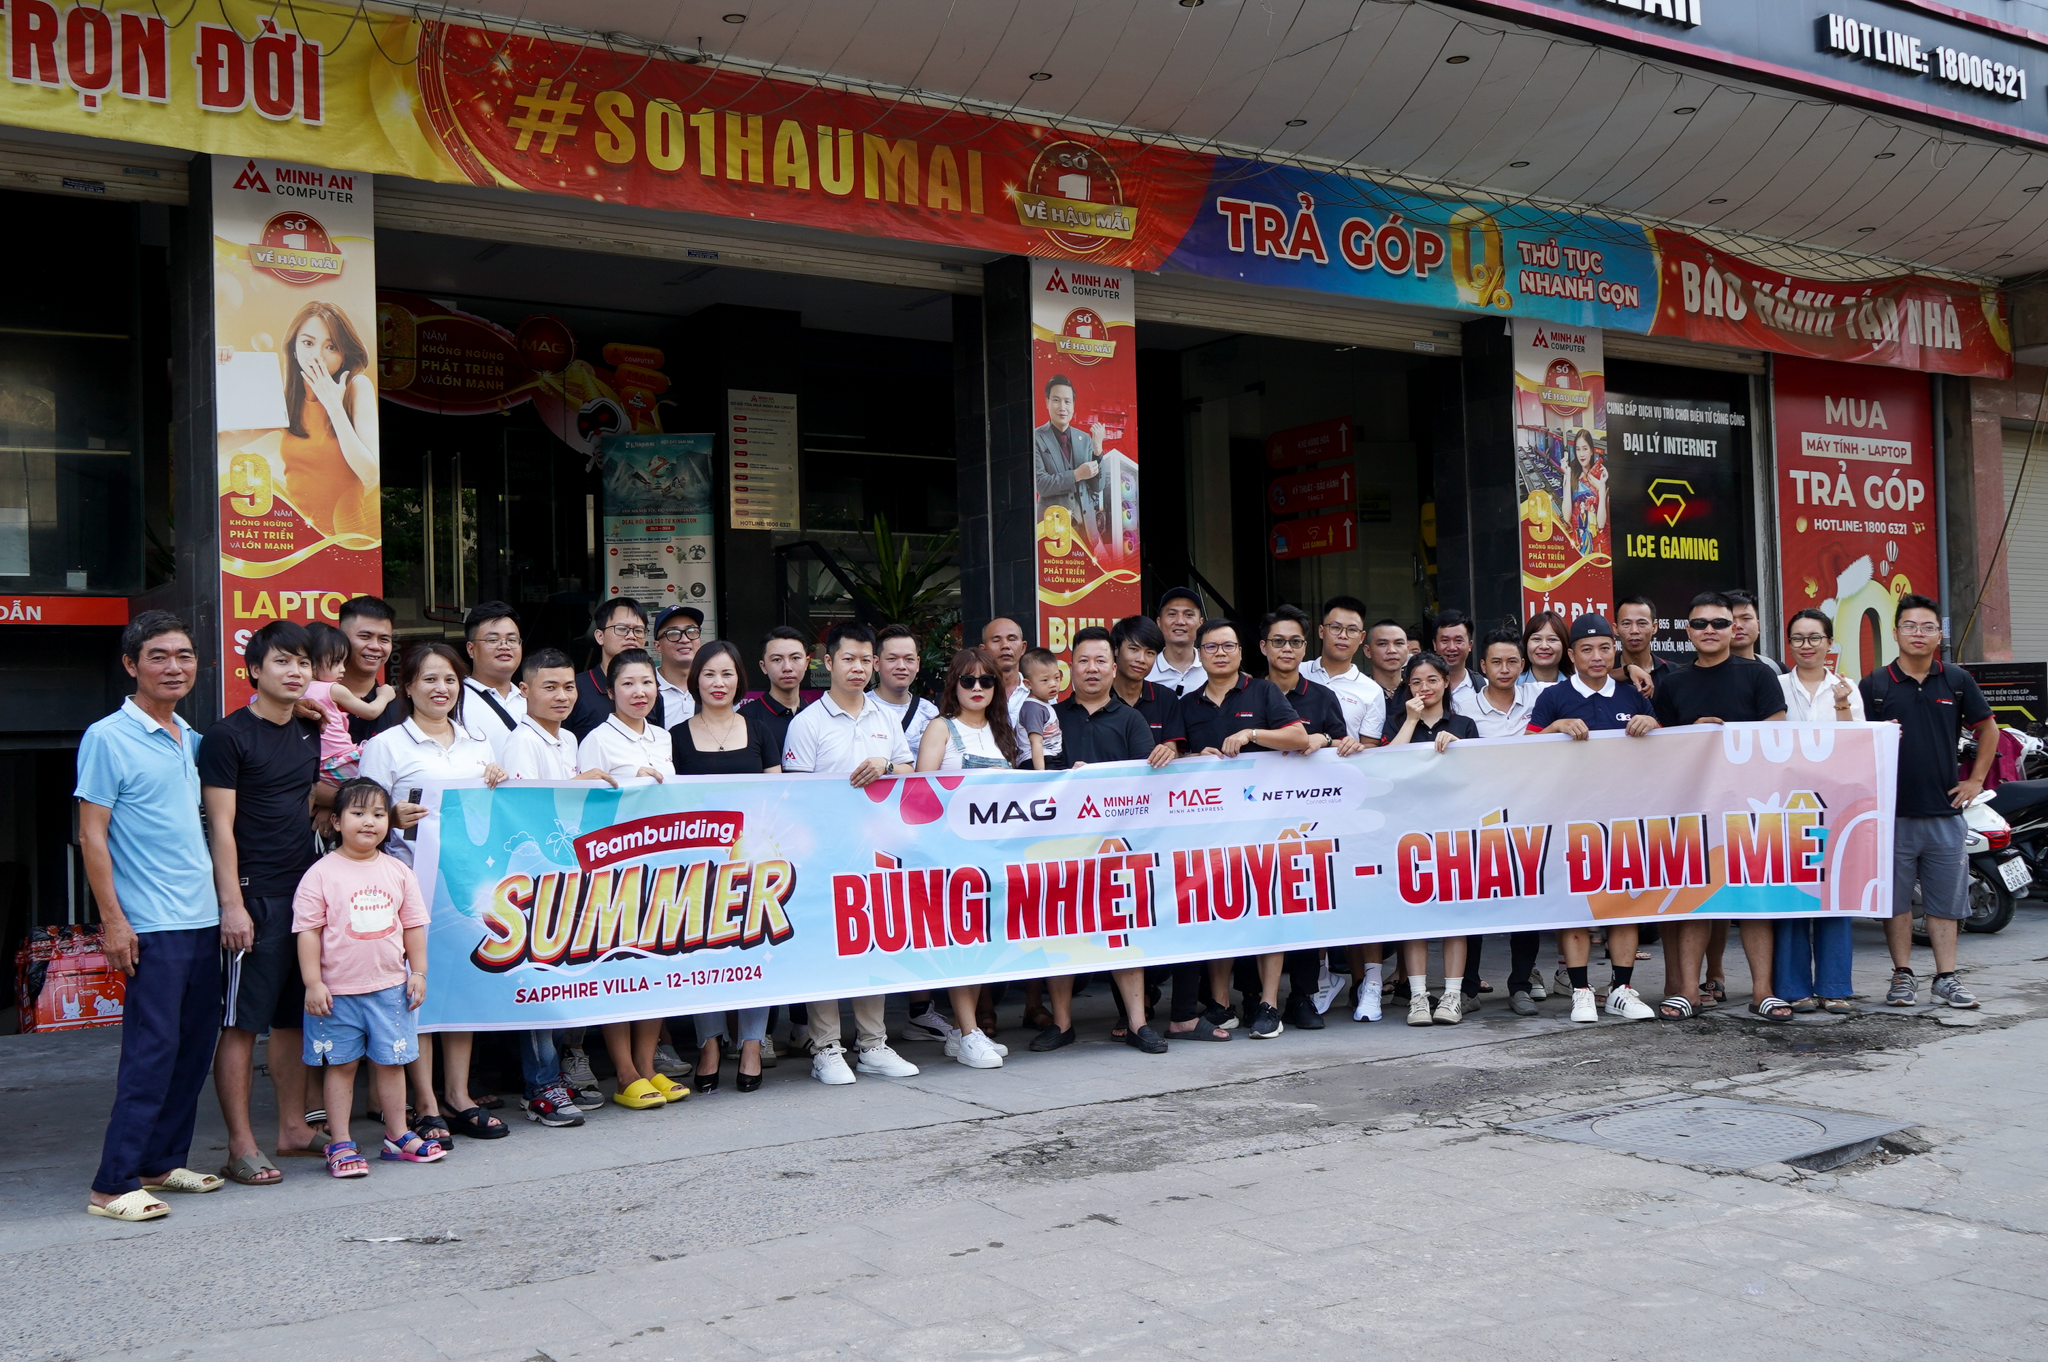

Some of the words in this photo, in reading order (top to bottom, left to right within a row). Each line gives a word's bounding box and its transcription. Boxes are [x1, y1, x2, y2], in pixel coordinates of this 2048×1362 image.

[0, 0, 166, 109] RỌN
[196, 19, 323, 124] ĐỜI
[1829, 13, 1929, 74] HOTLINE:
[1934, 45, 2027, 100] 18006321
[1058, 152, 1090, 171] SỐ
[275, 167, 323, 188] MINH
[328, 174, 354, 191] AN
[276, 184, 354, 204] COMPUTER
[283, 219, 309, 231] SỐ
[1023, 200, 1048, 220] VỀ
[1051, 207, 1091, 228] HẬU
[1096, 211, 1131, 231] MÃI
[1217, 191, 1329, 264] TRẢ
[1338, 212, 1446, 278] GÓP
[256, 250, 275, 263] VỀ
[276, 254, 307, 267] HẬU
[310, 257, 338, 270] MÃI
[1517, 238, 1560, 268] THỦ
[1563, 247, 1605, 277] TỤC
[1071, 273, 1101, 287] MINH
[1104, 278, 1120, 290] AN
[1520, 270, 1595, 301] NHANH
[1597, 281, 1640, 311] GỌN
[1072, 286, 1120, 300] COMPUTER
[1680, 253, 1748, 321] BẢO
[1905, 294, 1962, 350] NHÀ
[1076, 313, 1093, 324] SỐ
[422, 330, 447, 341] NĂM
[1550, 331, 1572, 343] MINH
[1574, 335, 1586, 345] AN
[421, 344, 461, 359] KHÔNG
[465, 349, 504, 361] NGỪNG
[522, 339, 565, 355] MAG
[1059, 339, 1071, 349] VỀ
[1072, 342, 1092, 353] HẬU
[1094, 343, 1112, 354] MÃI
[1550, 342, 1586, 353] COMPUTER
[421, 358, 459, 375] PHÁT
[464, 361, 504, 377] TRIỂN
[624, 357, 655, 365] COMPUTER
[1555, 363, 1570, 374] SỐ
[421, 375, 434, 386] VÀ
[436, 374, 461, 388] LỚN
[465, 378, 504, 391] MẠNH
[1541, 390, 1553, 400] VỀ
[1554, 393, 1570, 402] HẬU
[1571, 393, 1585, 403] MÃI
[1606, 402, 1624, 416] CUNG
[1625, 400, 1637, 416] CẤP
[1638, 405, 1653, 420] DỊCH
[1653, 406, 1662, 421] VỤ
[1662, 405, 1674, 420] TRÒ
[1675, 407, 1689, 422] CHƠI
[1690, 407, 1704, 425] ĐIỆN
[1704, 406, 1713, 424] TỬ
[1713, 409, 1729, 424] CÔNG
[1825, 395, 1888, 430] MUA
[1622, 432, 1644, 456] ĐẠI
[1646, 431, 1660, 454] LÝ
[1663, 435, 1718, 458] INTERNET
[1806, 436, 1831, 453] MÁY
[1833, 439, 1859, 455] TÍNH
[1868, 444, 1908, 458] LAPTOP
[230, 453, 273, 517] 9
[1789, 460, 1857, 508] TRẢ
[1863, 468, 1925, 512] GÓP
[274, 508, 293, 517] NĂM
[1528, 489, 1553, 542] 9
[229, 519, 261, 527] KHÔNG
[263, 520, 294, 528] NGỪNG
[1044, 505, 1073, 557] 9
[1814, 518, 1863, 533] HOTLINE:
[1864, 521, 1887, 534] 1800
[1888, 523, 1907, 536] 6321
[229, 529, 260, 539] PHÁT
[262, 528, 294, 541] TRIỂN
[241, 540, 262, 549] LỚN
[264, 542, 294, 552] MẠNH
[1626, 533, 1656, 558] I.CE
[1660, 535, 1719, 562] GAMING
[1065, 558, 1086, 566] NGỪNG
[1528, 551, 1546, 560] PHÁT
[1547, 551, 1565, 561] TRIỂN
[1043, 566, 1064, 575] PHÁT
[1065, 565, 1086, 576] TRIỂN
[1066, 577, 1086, 585] MẠNH
[233, 590, 371, 620] LAPTO
[1658, 618, 1670, 630] 855
[1676, 640, 1685, 654] HẠ
[969, 797, 1057, 825] MAG
[1103, 796, 1133, 808] MINH
[1135, 794, 1151, 806] AN
[1169, 787, 1223, 808] MAE
[1262, 787, 1343, 802] NETWORK
[1104, 806, 1149, 818] COMPUTER
[1197, 806, 1224, 814] EXPRESS
[586, 819, 736, 862] Teambuilding
[833, 849, 990, 957] BÙNG
[1005, 838, 1158, 948] NHIỆT
[1173, 821, 1338, 925] HUYẾT
[1396, 807, 1552, 905] CHÁY
[1565, 812, 1710, 894] ĐAM
[1723, 789, 1827, 886] MÊ
[474, 860, 796, 969] SUMMER
[514, 981, 599, 1005] SAPPHIRE
[603, 975, 650, 996] VILLA
